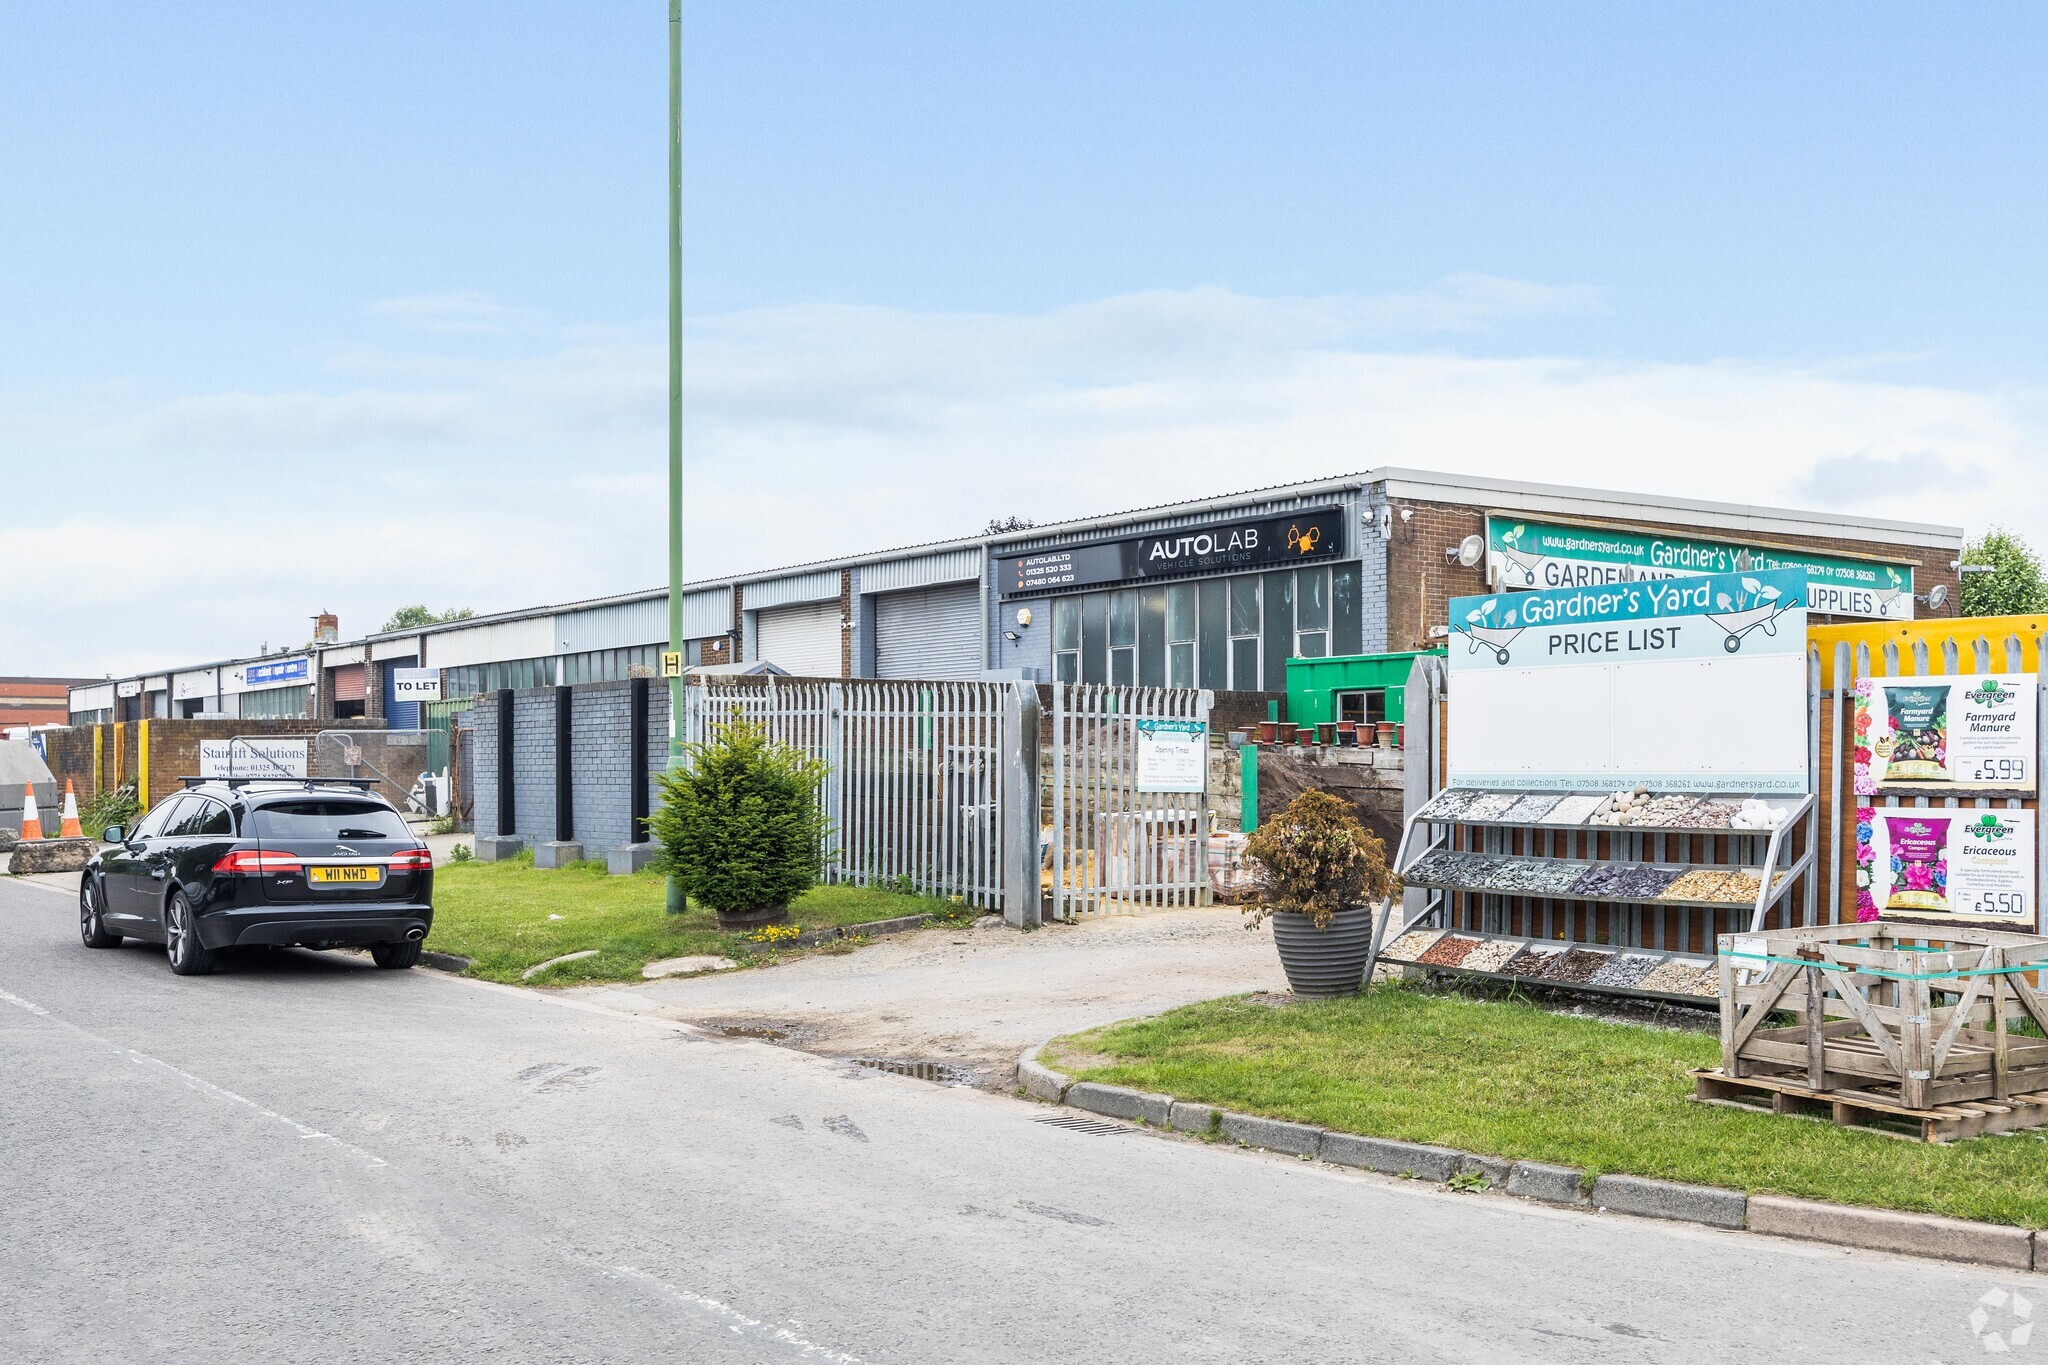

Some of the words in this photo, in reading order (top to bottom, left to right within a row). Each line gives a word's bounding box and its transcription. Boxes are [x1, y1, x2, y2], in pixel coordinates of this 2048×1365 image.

[1149, 529, 1258, 561] AUTOLAB
[1542, 535, 1645, 556] www.gardnersyard.co.uk
[1157, 559, 1194, 570] VEHICLE
[1199, 552, 1251, 566] SOLUTIONS
[1650, 541, 1726, 570] Gardner's
[1729, 548, 1764, 573] Yrd
[1026, 567, 1045, 576] 01325
[1045, 565, 1058, 574] 520
[1059, 563, 1072, 572] 333
[1803, 564, 1825, 576] 68174
[1835, 567, 1855, 580] 07508
[1026, 578, 1046, 587] 07480
[1522, 587, 1640, 624] Gardner's
[1647, 580, 1711, 615] Yard
[1807, 587, 1872, 613] UPPLIES
[1548, 631, 1619, 656] PRICE
[1628, 626, 1681, 651] LIST
[665, 654, 679, 675] H
[396, 682, 412, 691] TO
[416, 681, 438, 690] LET
[1965, 691, 2015, 700] Evergreen
[1900, 708, 1934, 716] Farmyard
[1965, 712, 2016, 723] Farmyard
[1178, 723, 1190, 732] Yard
[1969, 723, 2011, 732] Manure
[203, 746, 246, 759] Stairift
[250, 746, 304, 759] Solutions
[1452, 778, 1464, 786] For
[1466, 778, 1499, 787] deliveries
[1501, 779, 1515, 787] and
[1560, 779, 1575, 788] Tel:
[1601, 780, 1625, 788] 368174
[1639, 780, 1662, 788] 07508
[1665, 780, 1691, 788] 368261
[1693, 780, 1800, 789] www.gardnersyard.co.uk
[1964, 825, 2014, 834] Evergreen
[1900, 838, 1936, 846] Ericaceous
[1963, 845, 2017, 856] Ericaceous
[1971, 856, 2009, 866] Compost
[1974, 892, 2023, 913] £5.50
